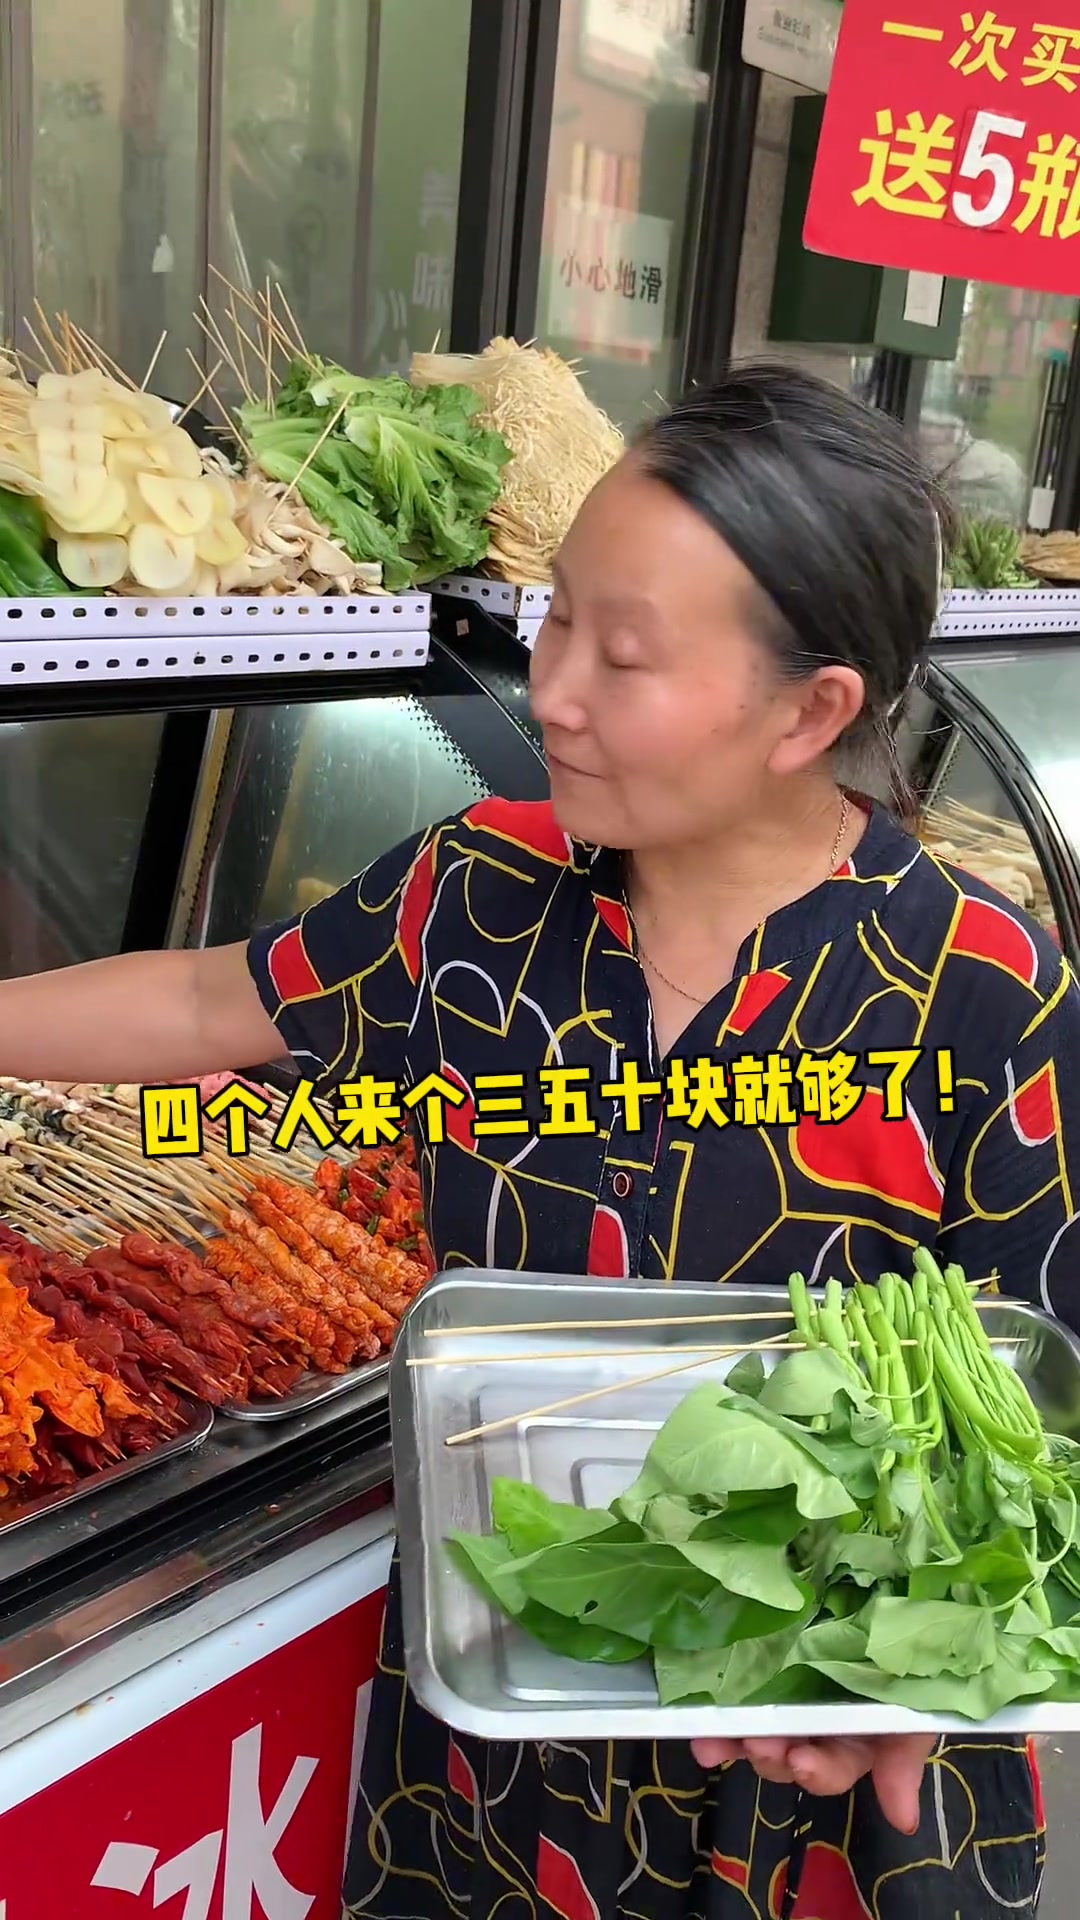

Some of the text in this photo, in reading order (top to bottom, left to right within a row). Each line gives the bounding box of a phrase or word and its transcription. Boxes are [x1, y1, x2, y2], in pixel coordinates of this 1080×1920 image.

[882, 10, 1080, 93] 一次买
[560, 254, 662, 304] 小心地滑
